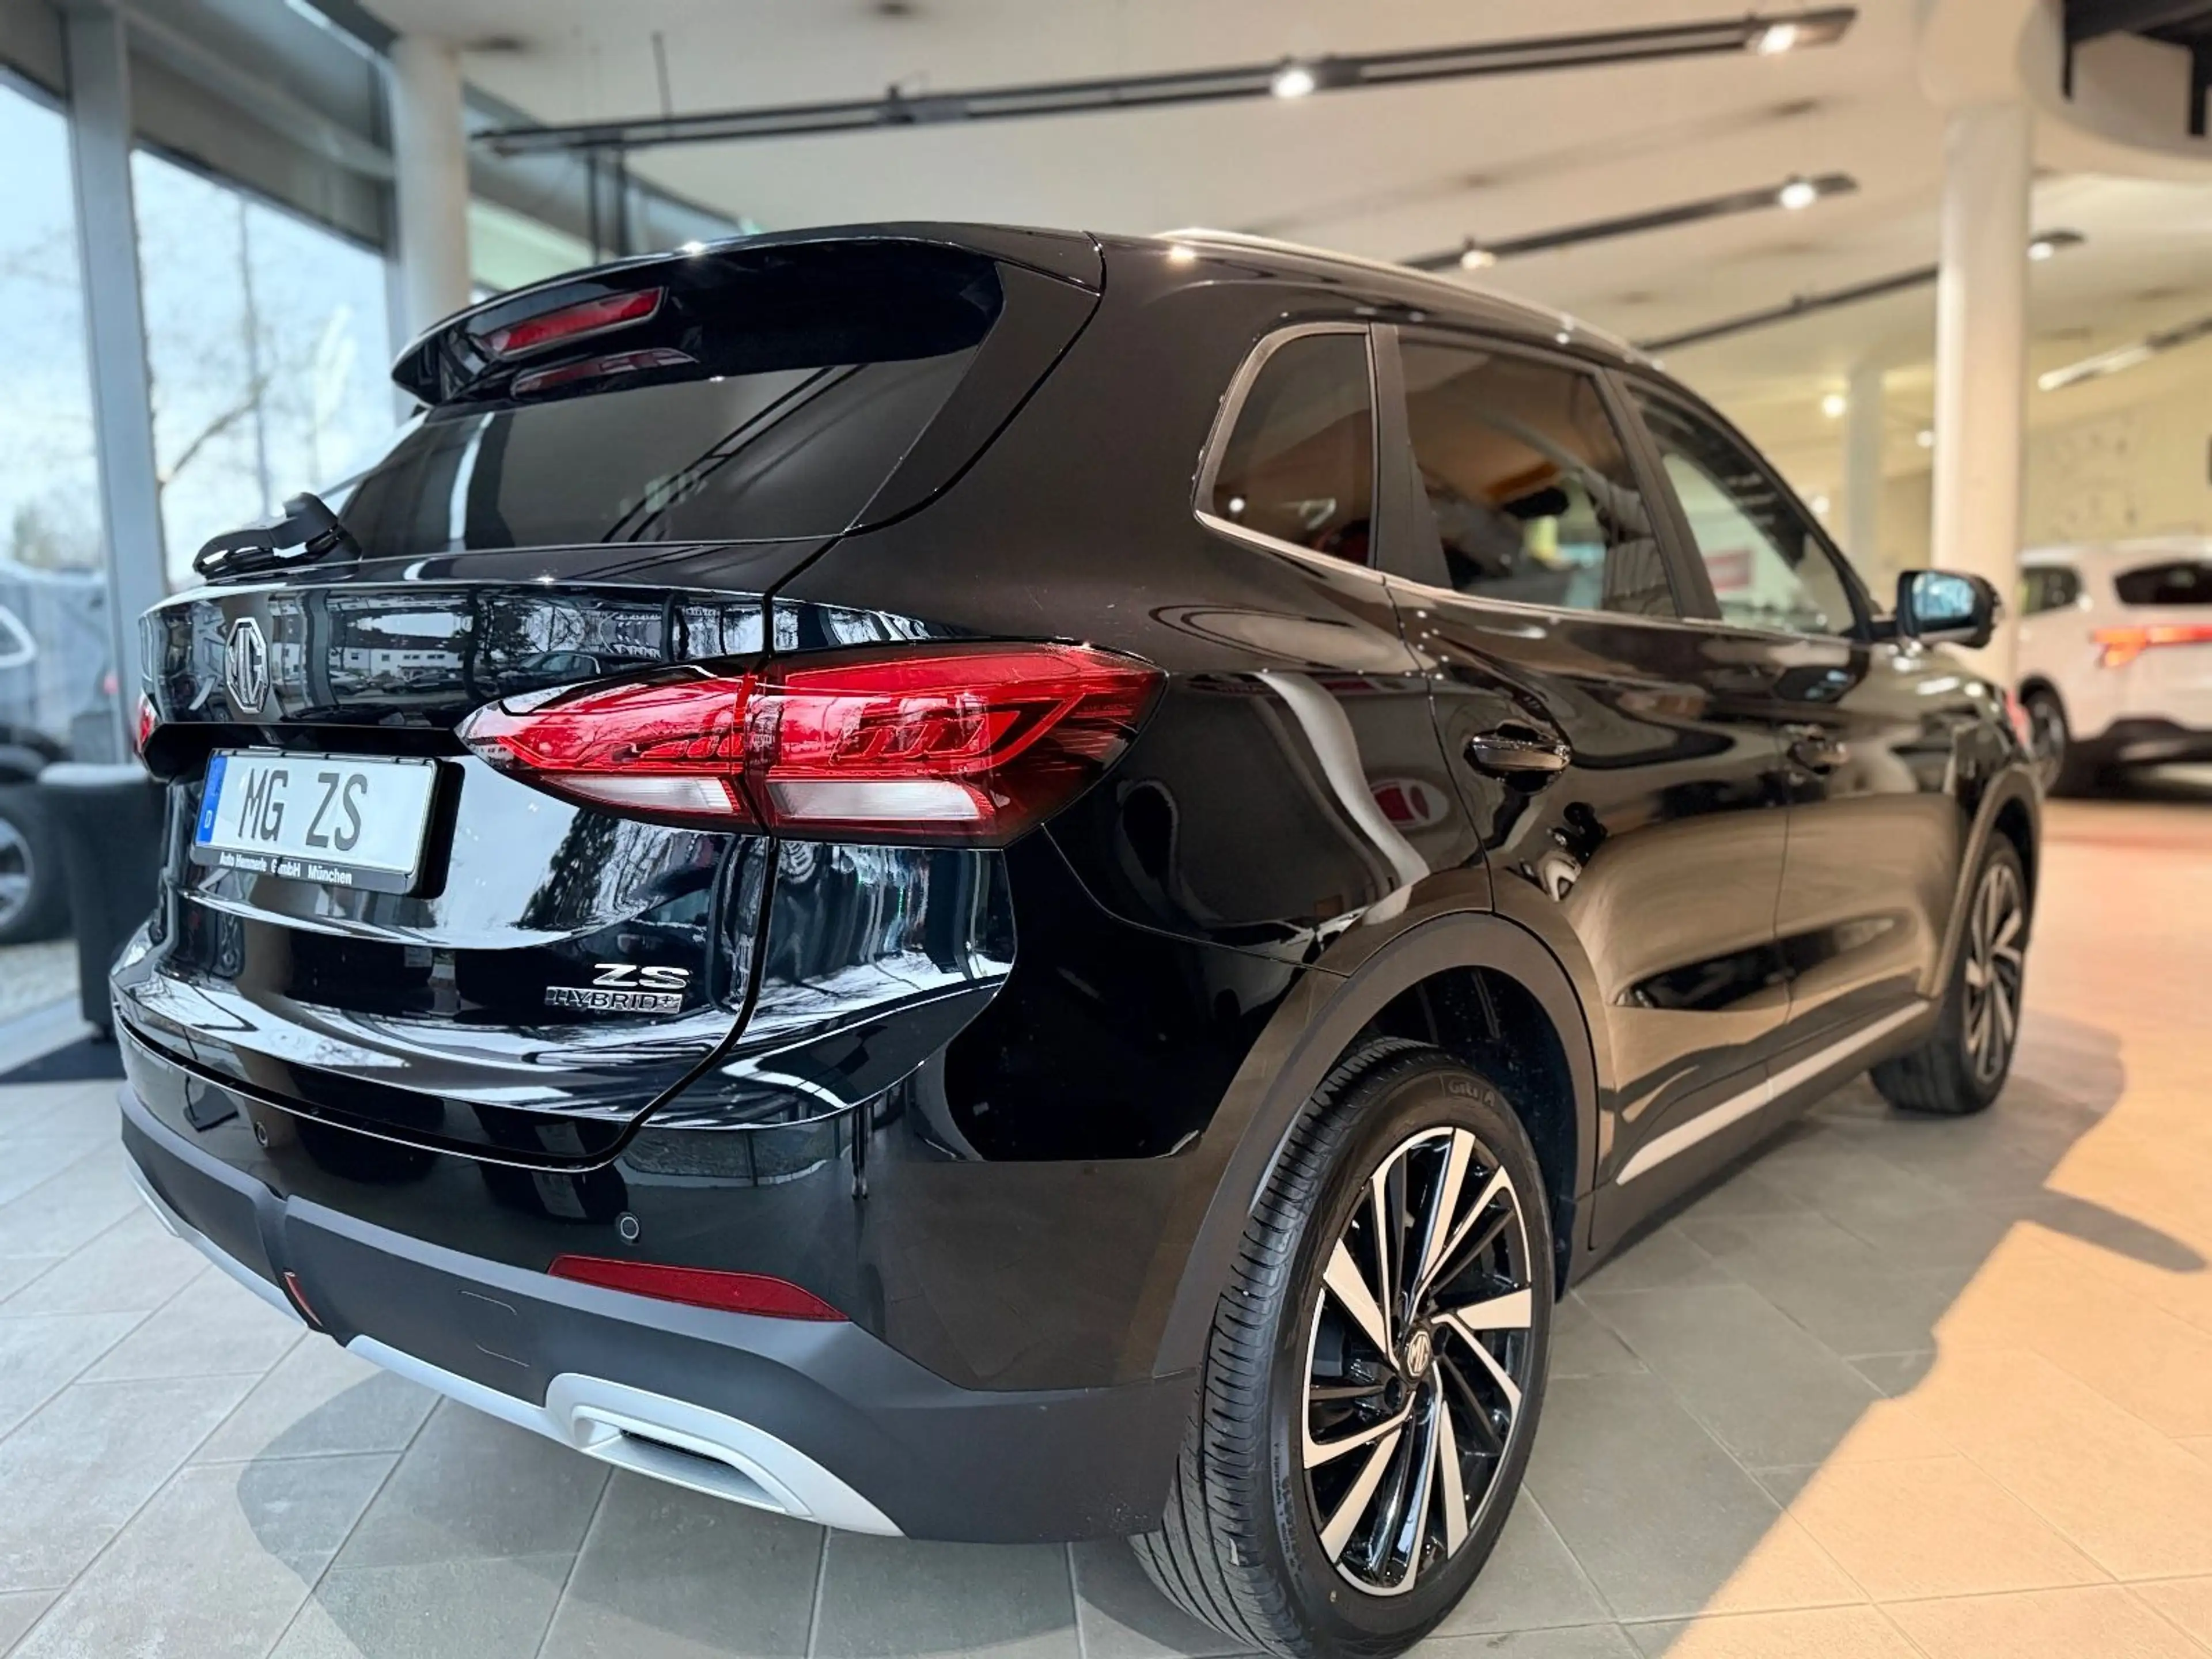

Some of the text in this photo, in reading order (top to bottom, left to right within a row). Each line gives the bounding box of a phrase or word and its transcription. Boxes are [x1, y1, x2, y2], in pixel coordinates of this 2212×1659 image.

[227, 623, 267, 708] MG
[237, 768, 368, 851] MG ZS
[219, 851, 235, 866] Auto
[308, 864, 353, 885] München
[592, 963, 690, 989] ZS
[551, 987, 675, 1010] HYBRID+
